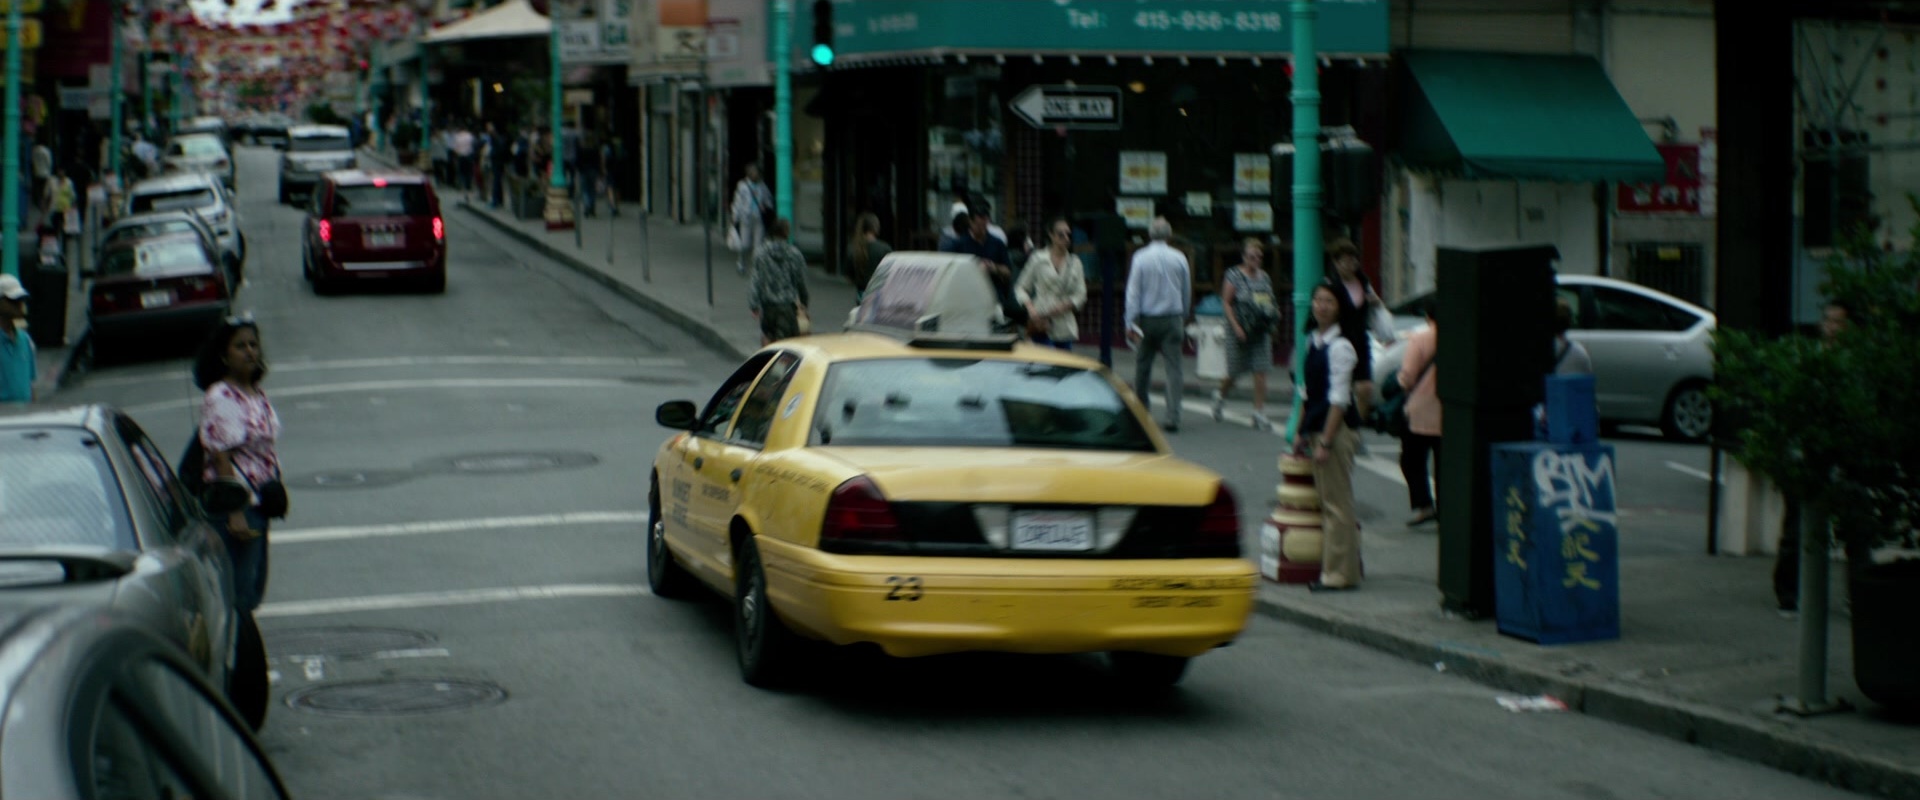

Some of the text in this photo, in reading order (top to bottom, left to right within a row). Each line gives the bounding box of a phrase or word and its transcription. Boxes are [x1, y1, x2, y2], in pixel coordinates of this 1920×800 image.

[1042, 97, 1109, 117] ONE WAY
[884, 575, 924, 602] 23
